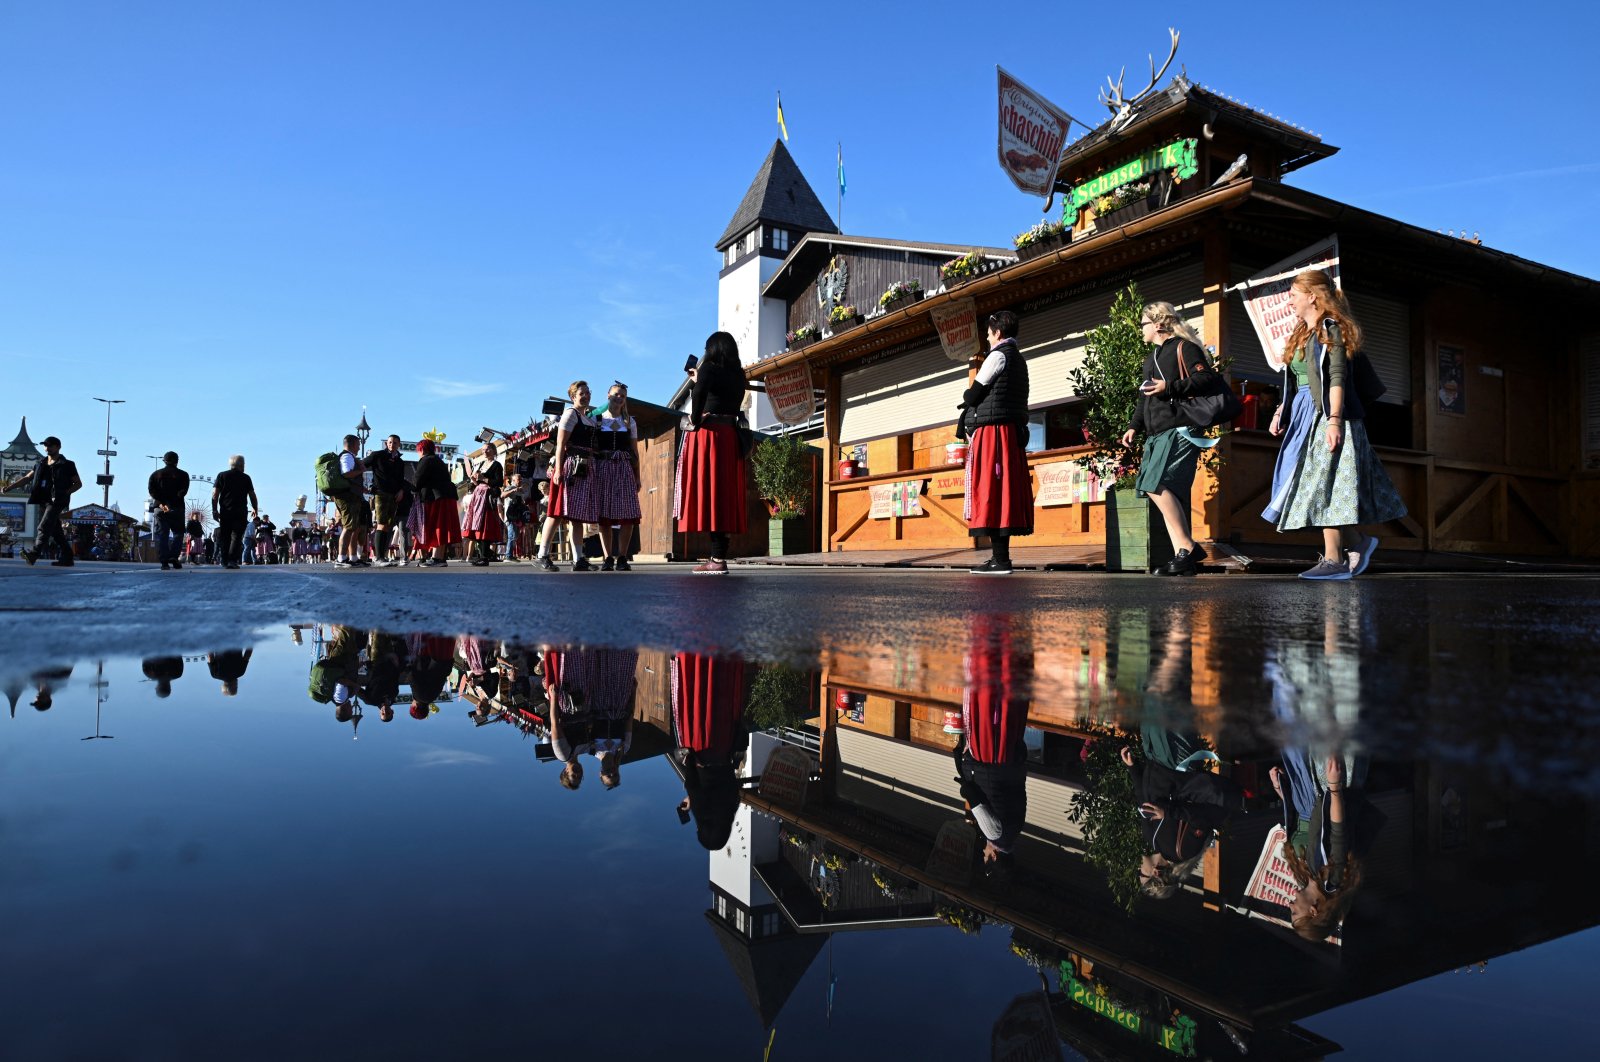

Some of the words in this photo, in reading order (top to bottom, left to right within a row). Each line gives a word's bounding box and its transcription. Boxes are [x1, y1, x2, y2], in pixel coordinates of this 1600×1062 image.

[1008, 88, 1057, 131] Original
[946, 324, 972, 346] Spezial
[776, 391, 808, 410] Bratwurst
[1042, 469, 1071, 485] Coca-Cola
